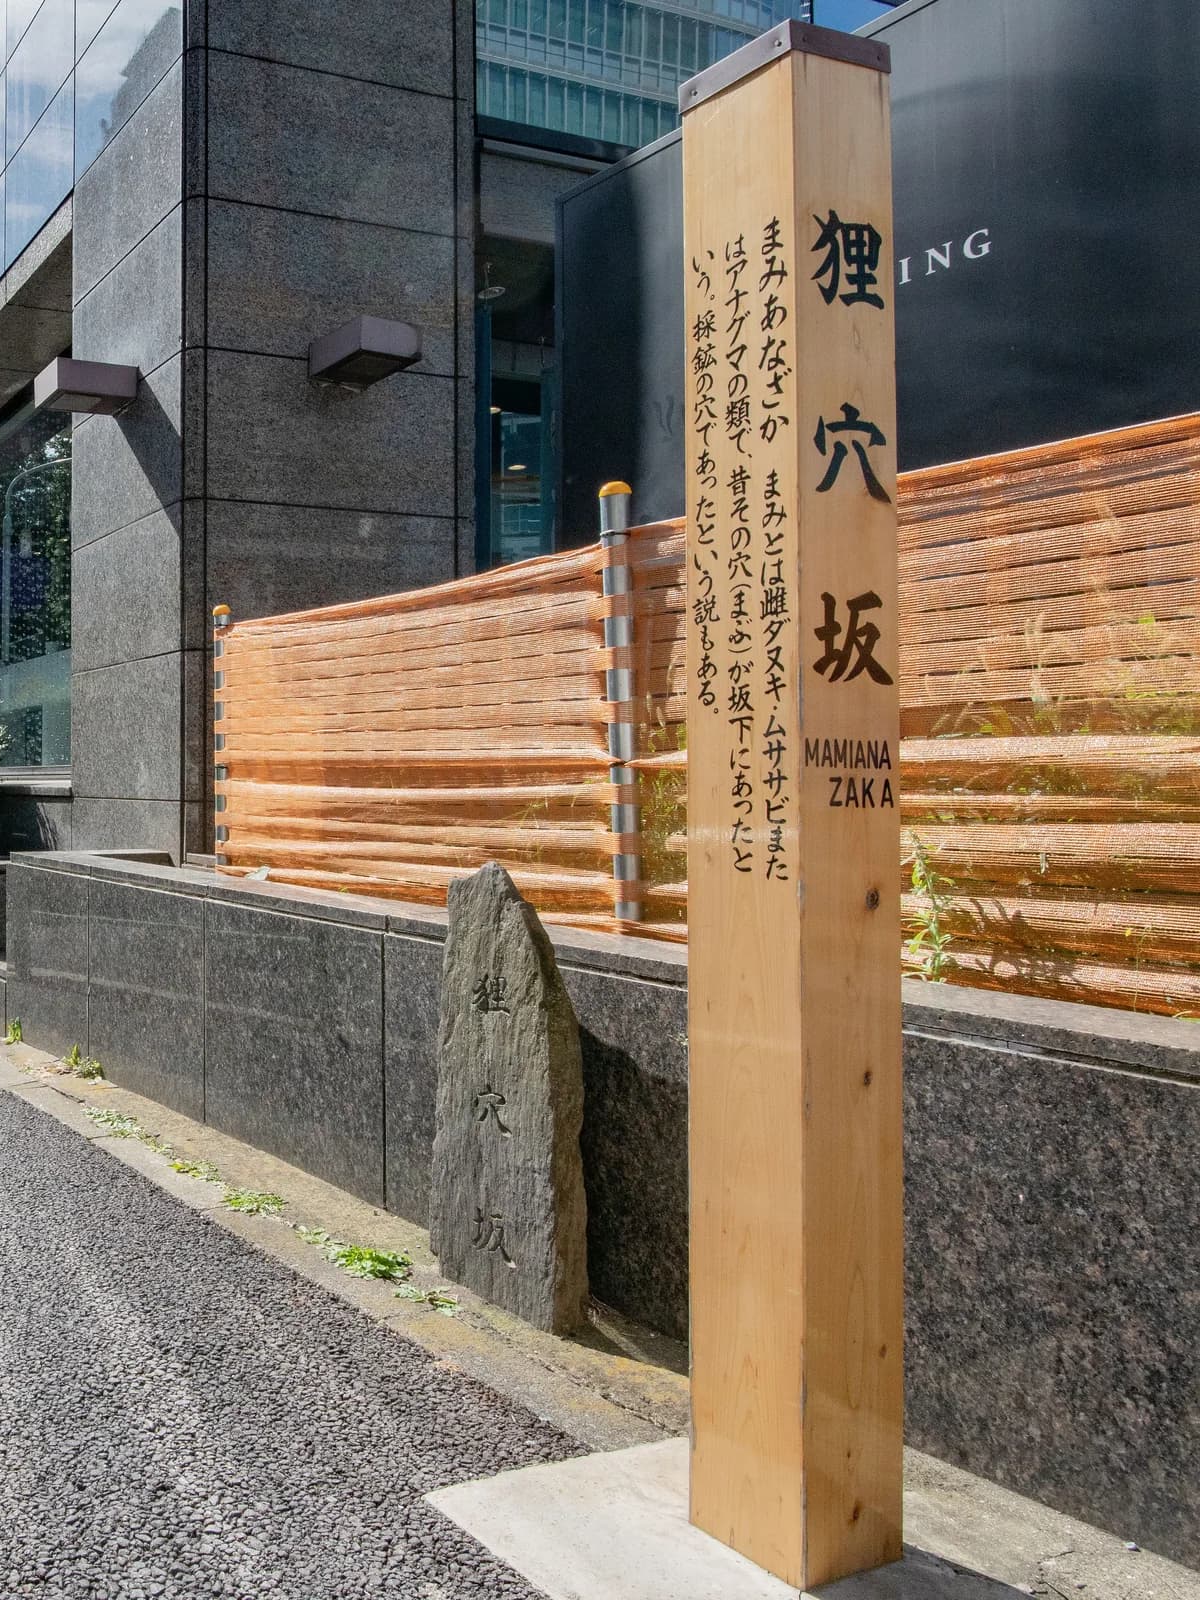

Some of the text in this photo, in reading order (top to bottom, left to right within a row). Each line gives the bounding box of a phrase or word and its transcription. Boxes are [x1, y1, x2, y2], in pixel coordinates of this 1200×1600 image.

[898, 228, 992, 285] ING
[758, 215, 792, 444] まみあなざか
[811, 208, 894, 686] 狸穴坂
[804, 737, 892, 770] MAMIANA
[828, 776, 895, 809] ZAKA
[471, 973, 517, 1269] 狸穴坂
